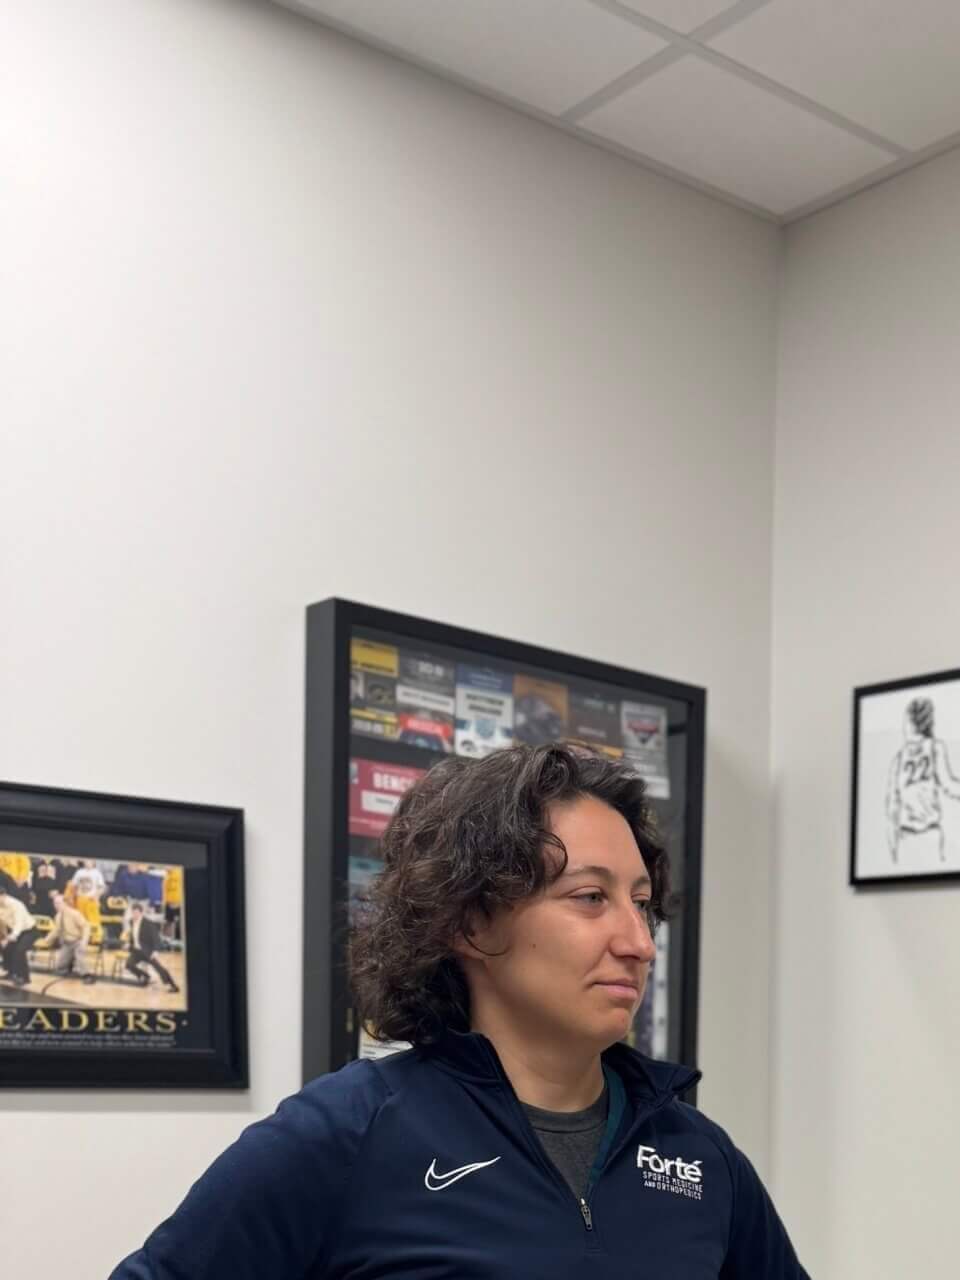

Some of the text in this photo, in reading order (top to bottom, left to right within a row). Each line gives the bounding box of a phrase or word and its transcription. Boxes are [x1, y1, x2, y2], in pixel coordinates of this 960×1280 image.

[903, 755, 930, 787] 22
[636, 1144, 703, 1183] Forté
[642, 1170, 703, 1193] SPORTS MEDICINE
[643, 1180, 702, 1201] AND ORTHOPEDICS
